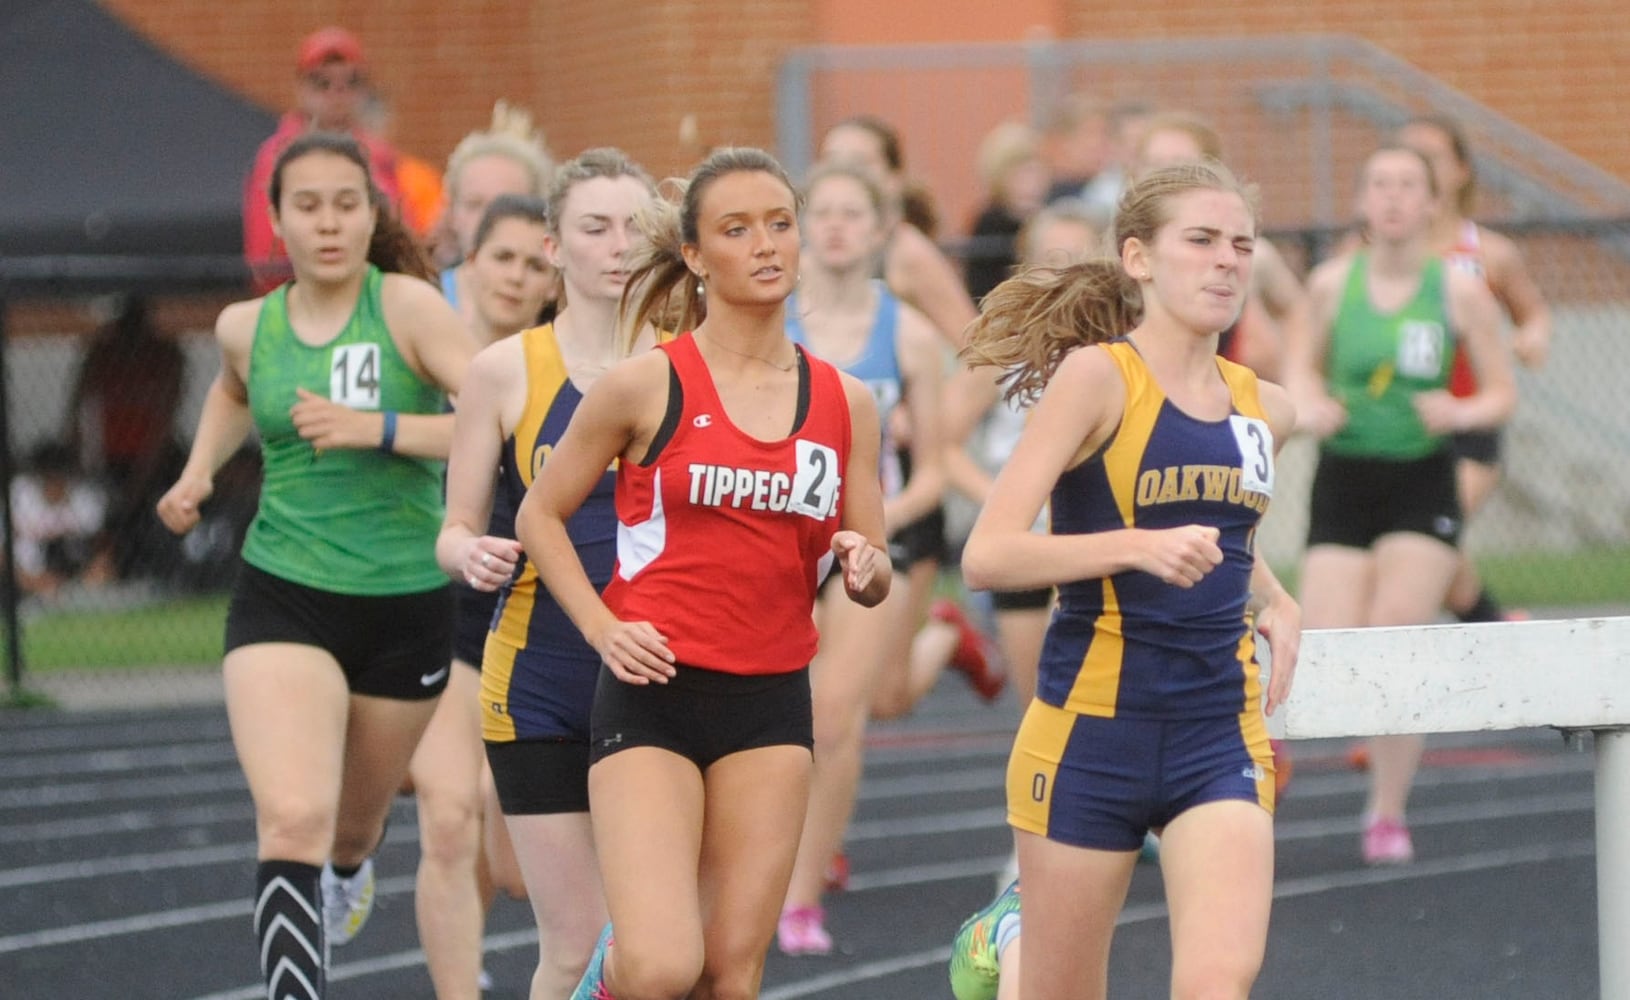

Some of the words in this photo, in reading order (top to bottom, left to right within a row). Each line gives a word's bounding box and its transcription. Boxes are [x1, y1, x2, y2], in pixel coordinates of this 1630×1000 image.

[335, 348, 379, 399] 14
[803, 448, 827, 508] 2
[1247, 423, 1268, 483] 3
